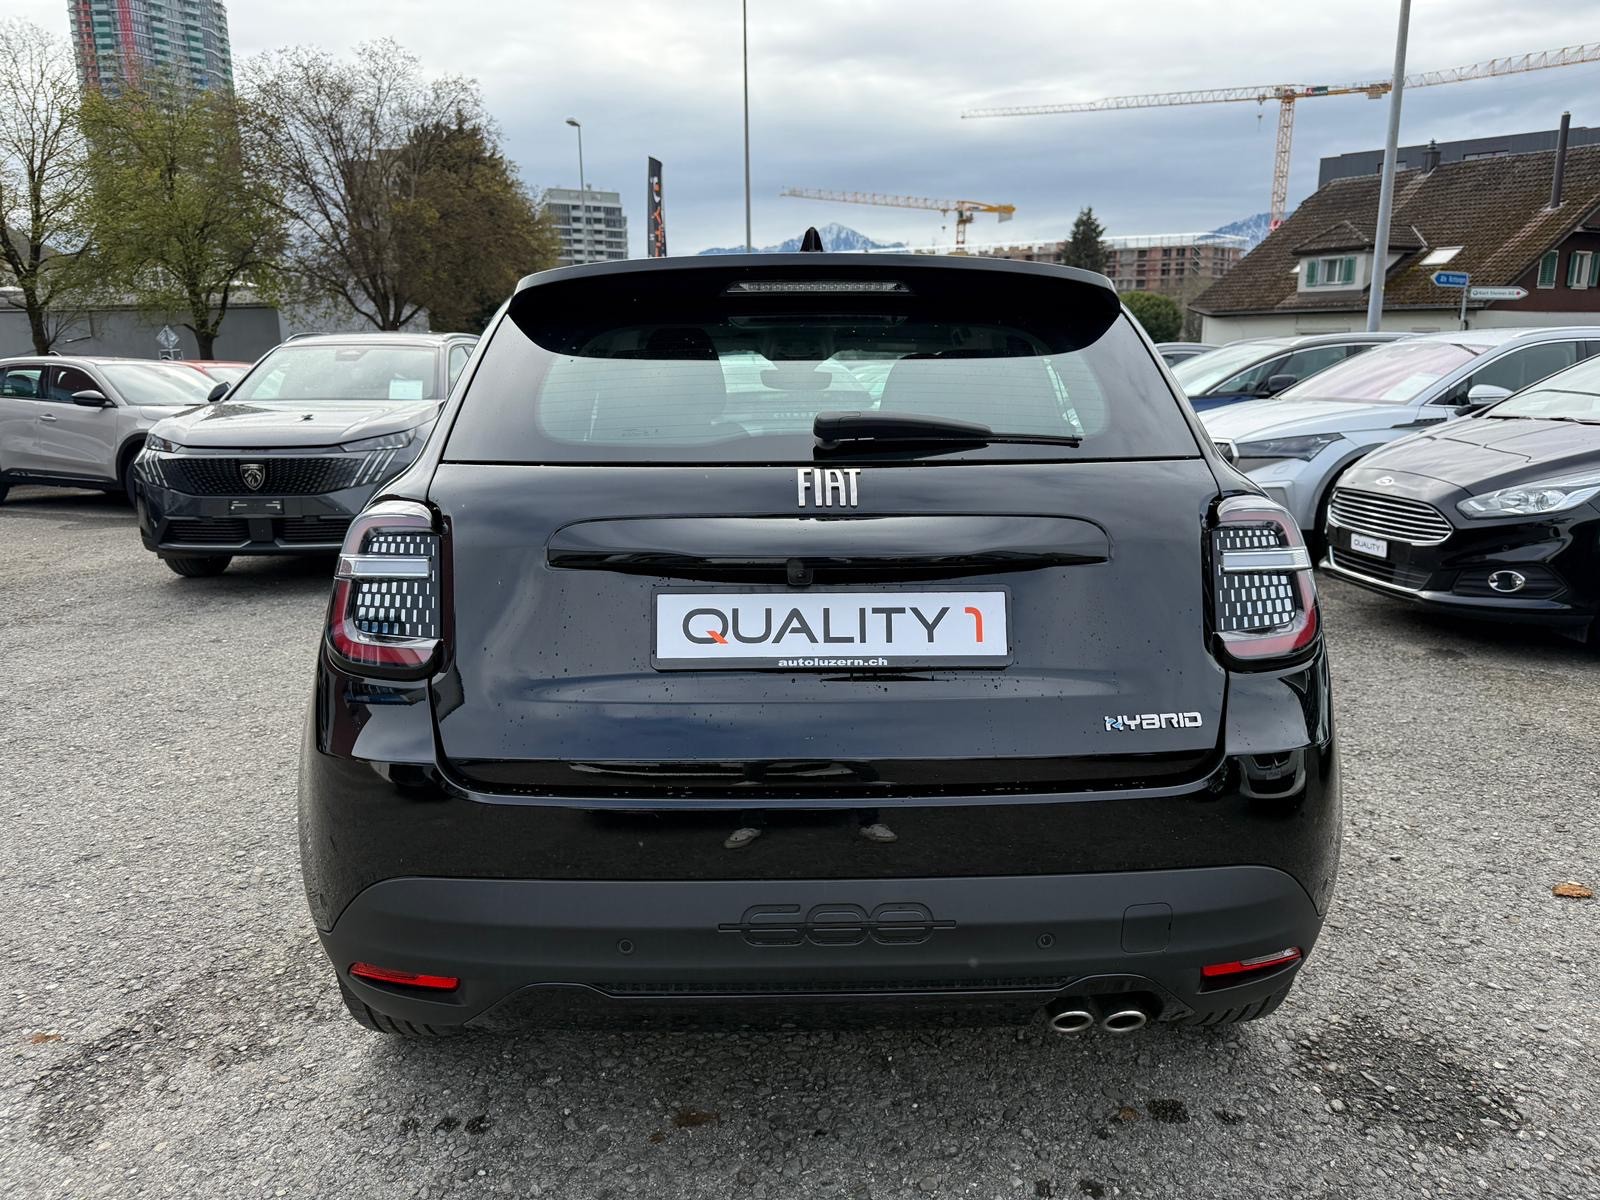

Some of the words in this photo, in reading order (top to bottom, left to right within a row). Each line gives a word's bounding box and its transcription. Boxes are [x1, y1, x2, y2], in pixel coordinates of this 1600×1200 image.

[797, 468, 861, 507] FIAT
[1354, 538, 1380, 552] QUALITY
[682, 606, 951, 645] QUALITY
[964, 606, 984, 643] 1
[778, 657, 888, 667] autoluzern.ch
[1104, 711, 1203, 731] HYBRID
[740, 901, 935, 947] 600
